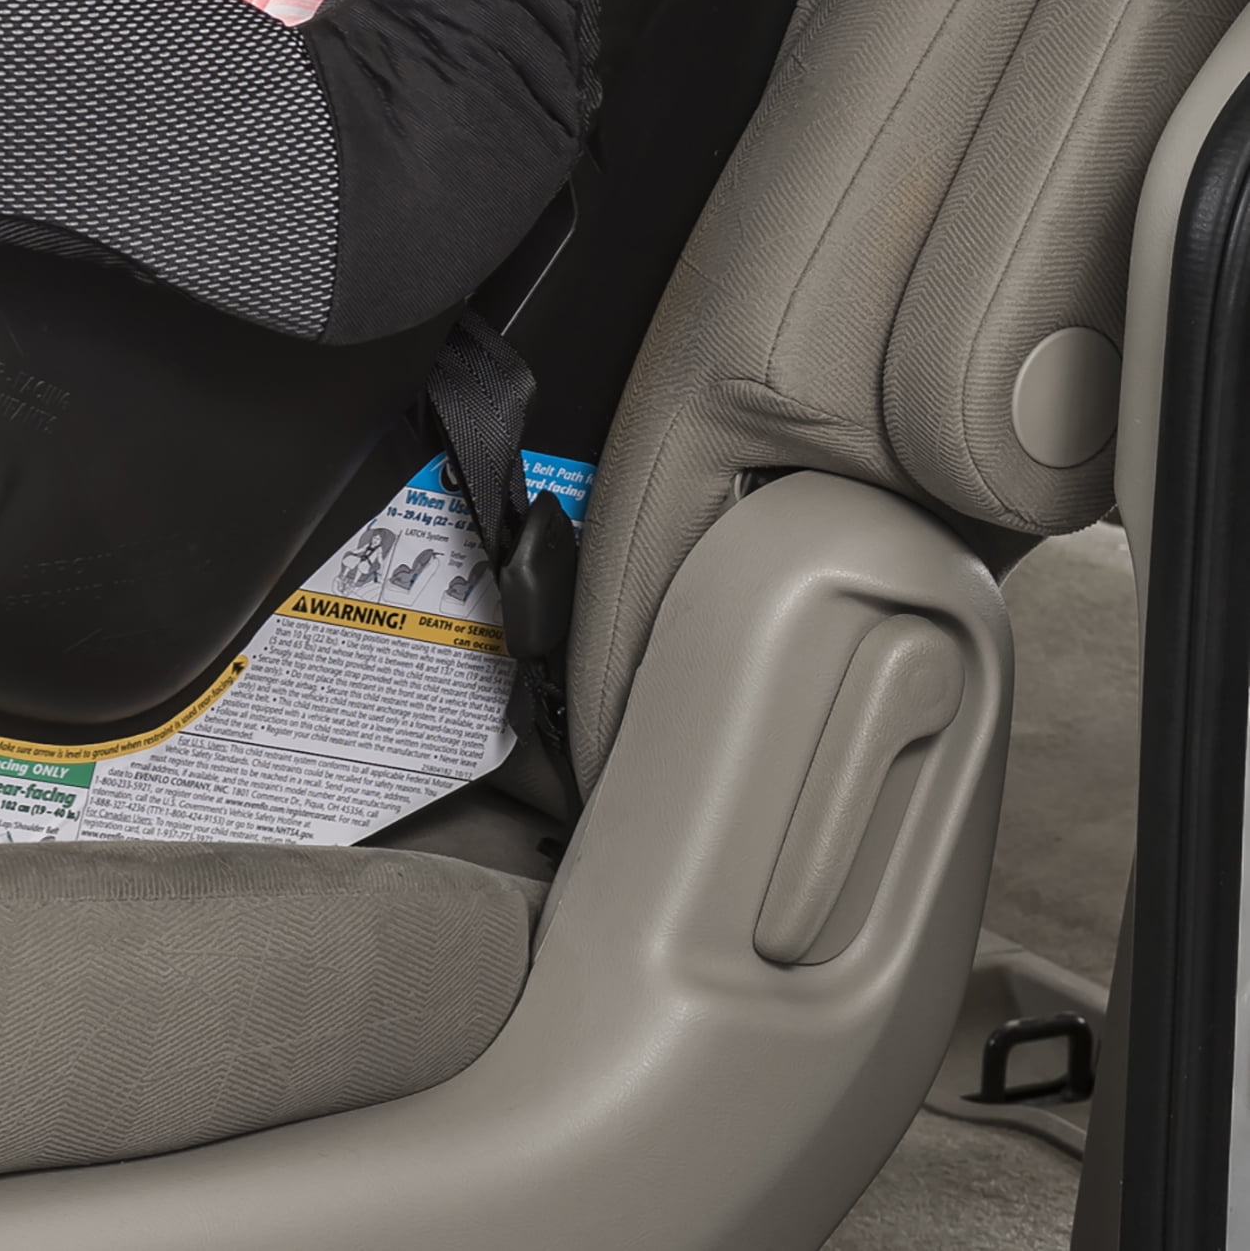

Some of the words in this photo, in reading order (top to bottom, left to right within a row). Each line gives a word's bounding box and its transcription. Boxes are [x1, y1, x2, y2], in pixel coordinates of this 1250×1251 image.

[532, 462, 555, 476] Belt
[556, 467, 584, 483] Path
[405, 489, 445, 511] When
[387, 506, 397, 517] 10
[403, 510, 420, 521] 29.4
[421, 513, 432, 525] kg
[432, 515, 448, 526] (22
[404, 528, 425, 538] LATCH
[426, 531, 449, 542] System
[310, 597, 407, 630] WARNING!
[418, 616, 452, 630] DEATH
[454, 624, 466, 633] or
[453, 637, 471, 647] can
[16, 745, 32, 755] sure
[32, 748, 56, 758] arrow
[64, 748, 82, 759] level
[83, 749, 91, 758] to
[91, 745, 119, 759] ground
[121, 740, 142, 751] when
[143, 725, 173, 745] restraint
[181, 707, 198, 723] used
[31, 762, 69, 779] ONLY
[0, 799, 17, 810] 102
[17, 804, 29, 812] cm
[30, 804, 46, 815] (19
[53, 808, 64, 818] 40
[66, 810, 80, 823] in.)
[47, 826, 59, 835] Belt
